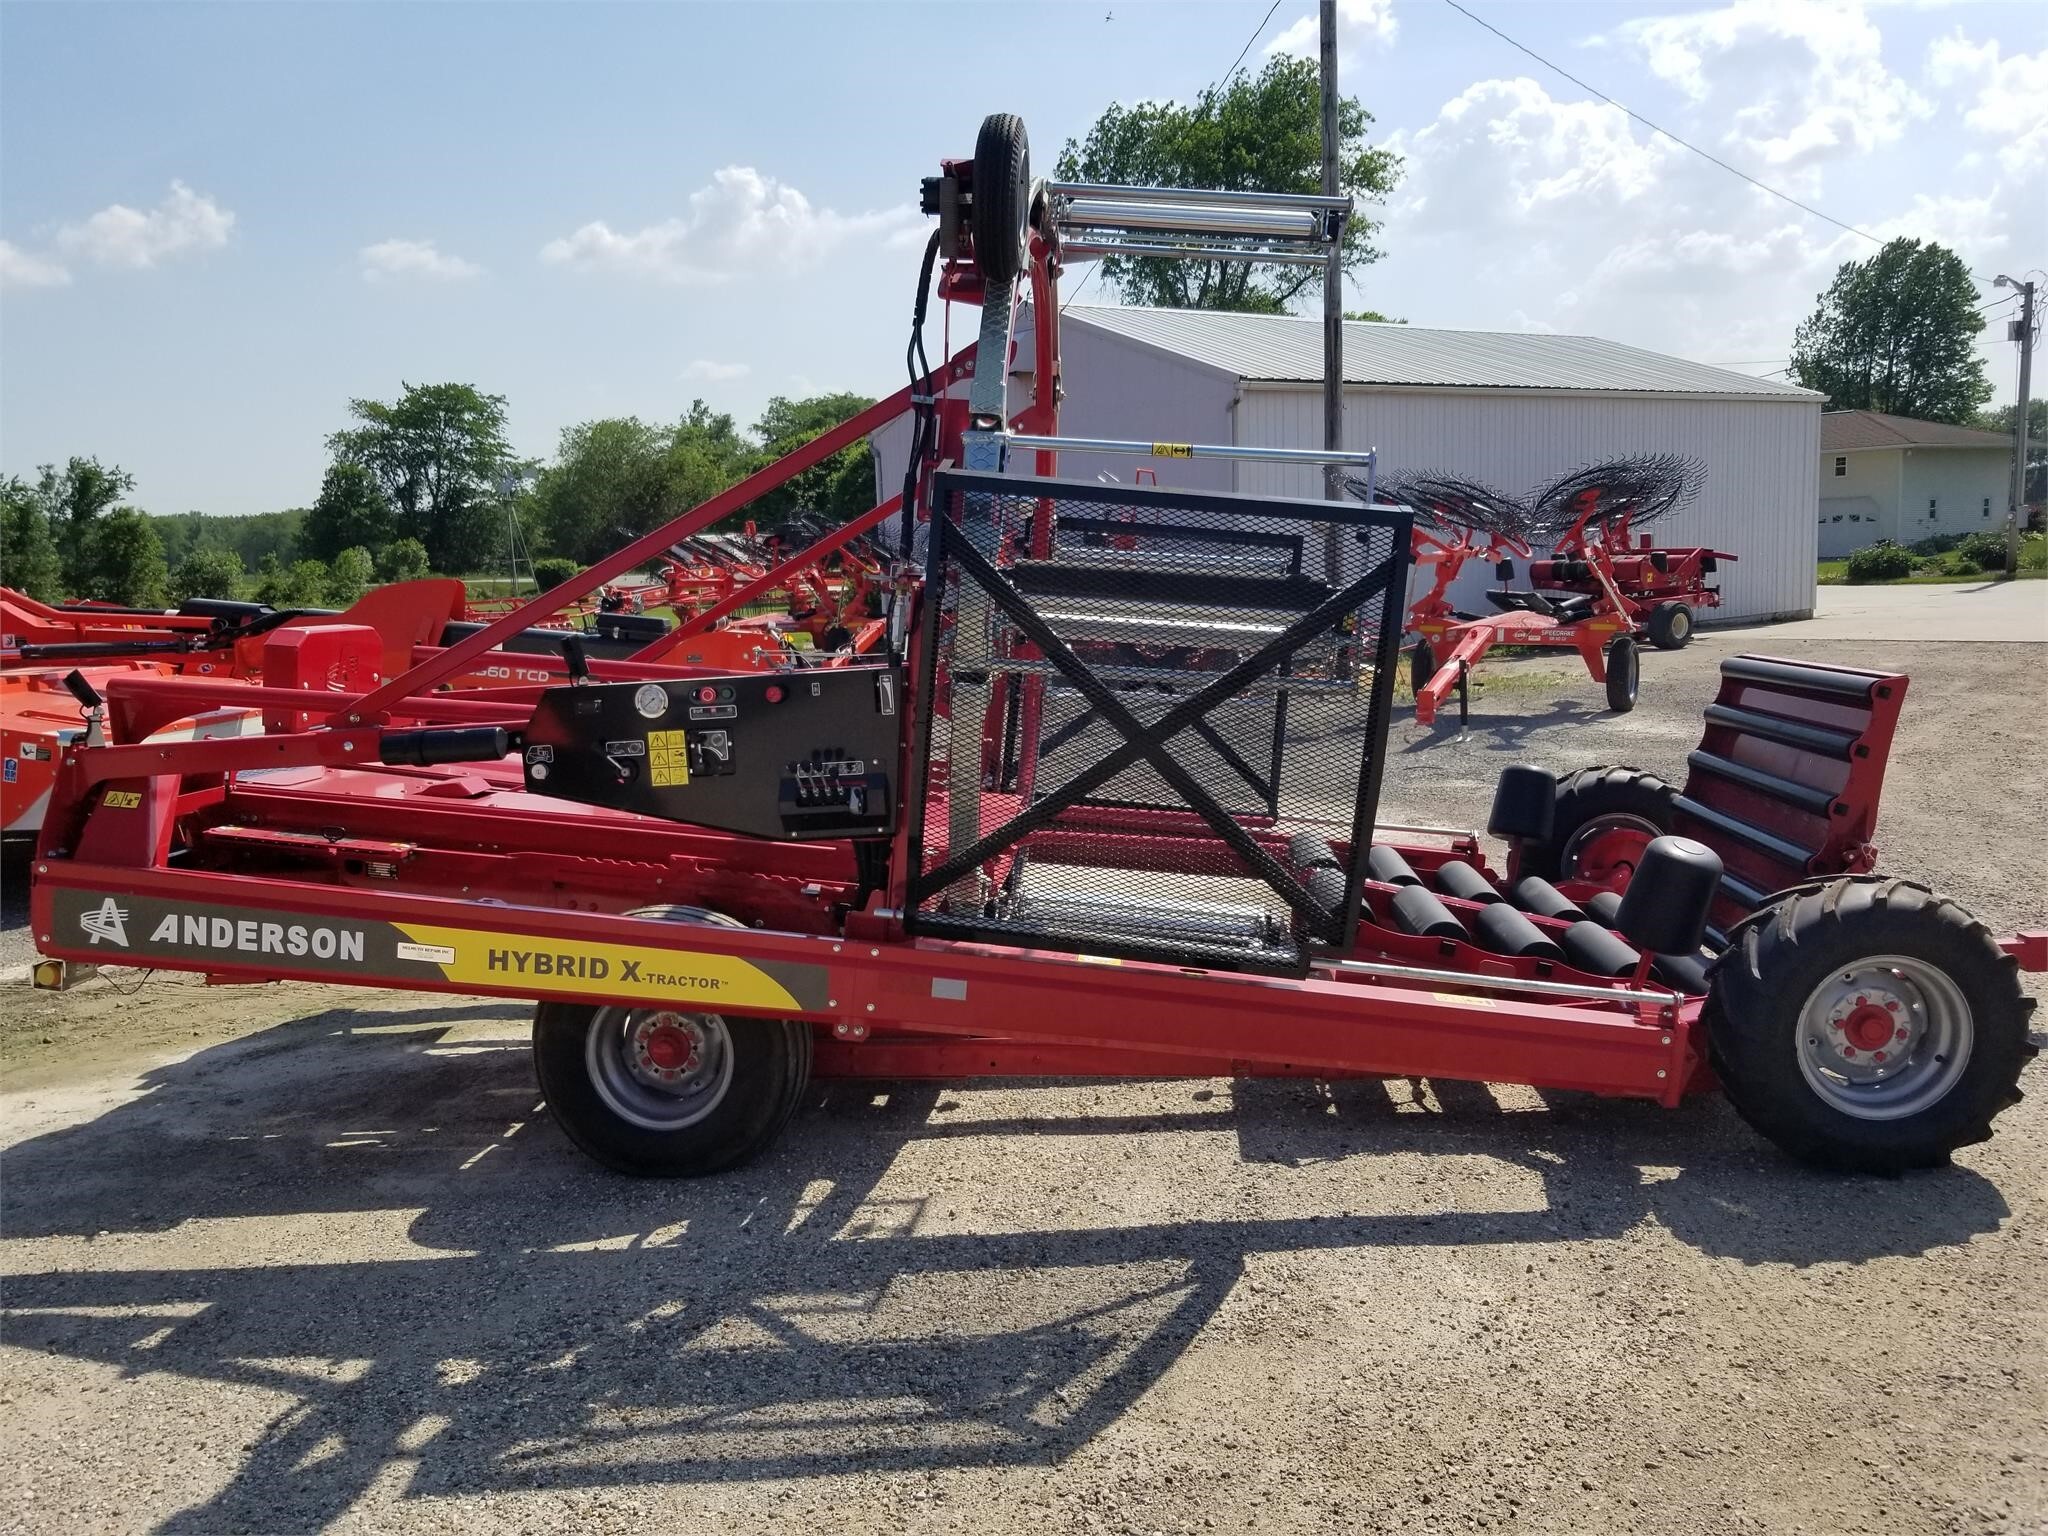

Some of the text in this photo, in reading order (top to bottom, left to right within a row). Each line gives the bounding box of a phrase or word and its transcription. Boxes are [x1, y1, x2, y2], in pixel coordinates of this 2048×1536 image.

[516, 669, 550, 682] TCD
[149, 913, 364, 962] ANDERSON
[488, 948, 610, 980] HYBRID
